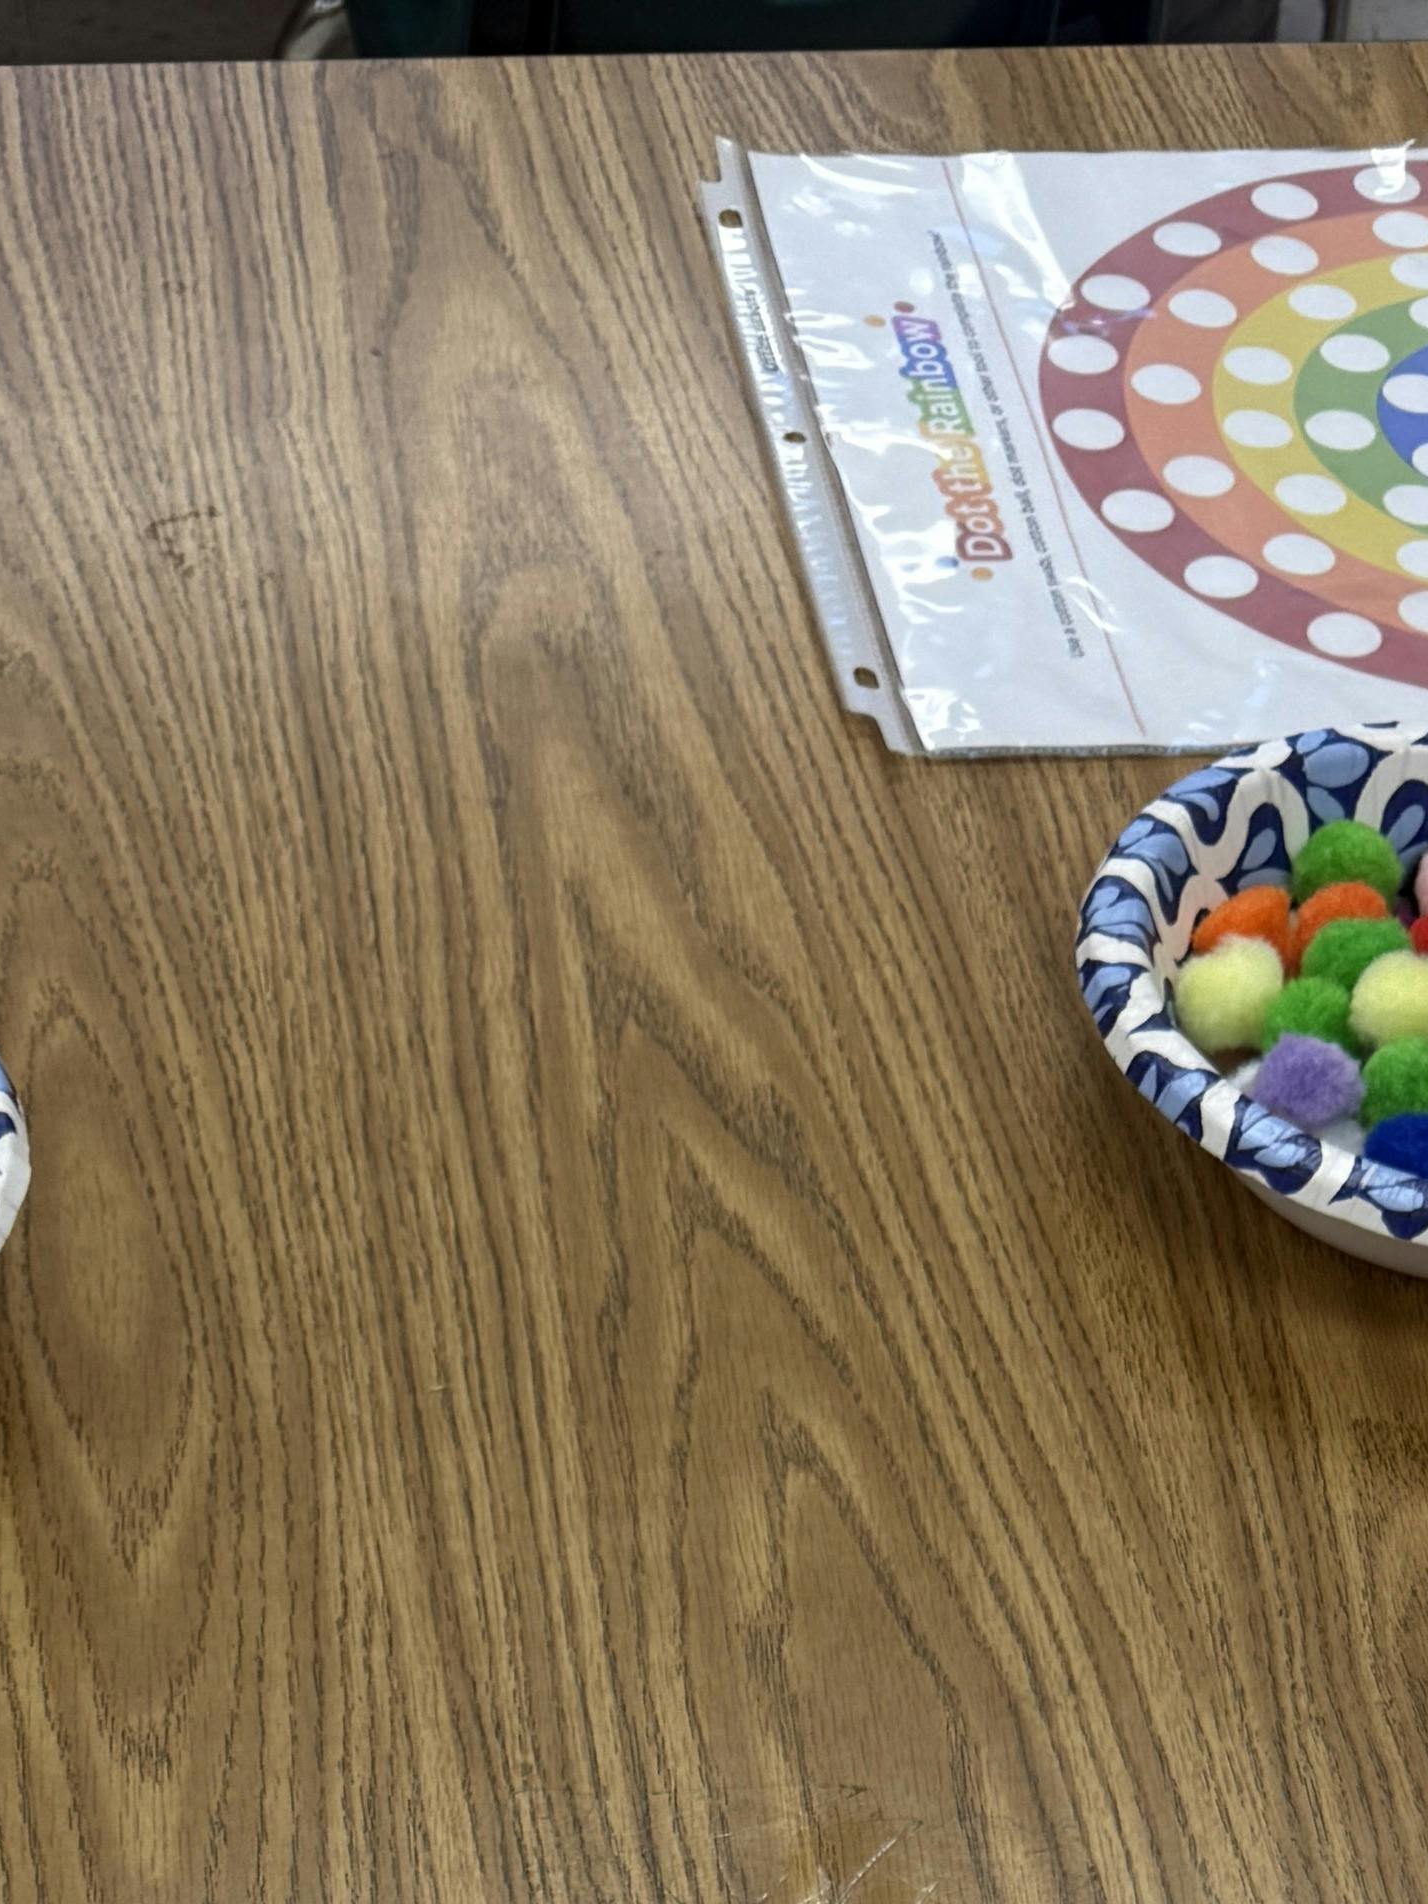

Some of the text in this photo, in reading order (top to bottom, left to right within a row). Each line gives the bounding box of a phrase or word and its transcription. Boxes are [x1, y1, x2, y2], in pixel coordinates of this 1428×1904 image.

[902, 323, 1006, 556] Dot the Rainbow
